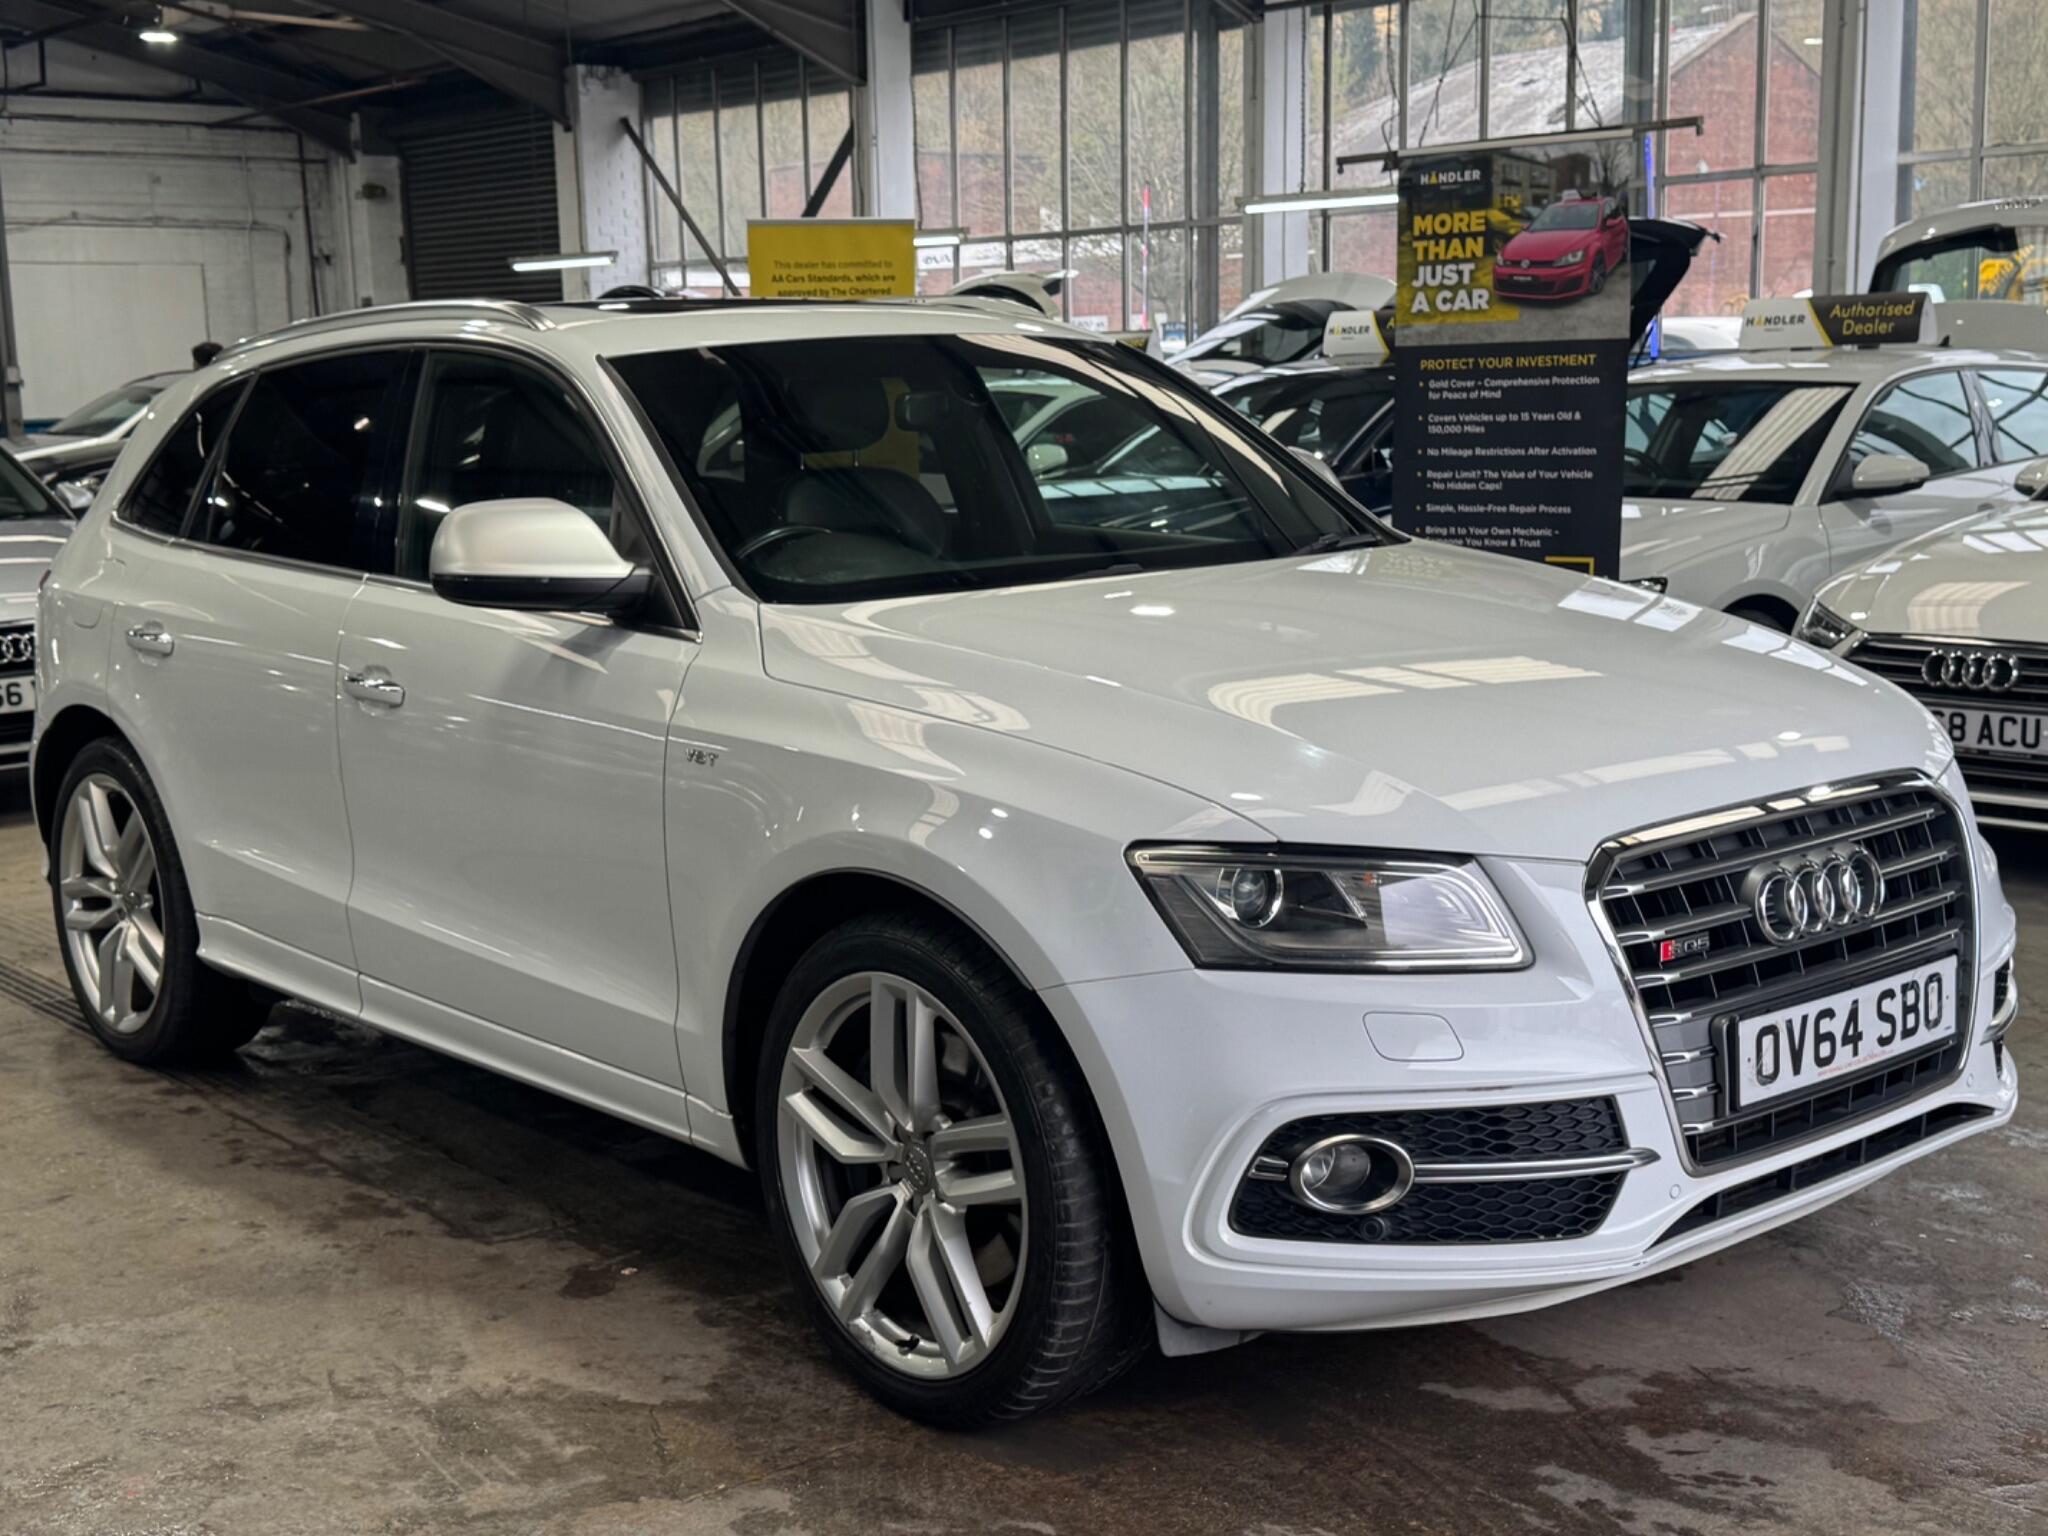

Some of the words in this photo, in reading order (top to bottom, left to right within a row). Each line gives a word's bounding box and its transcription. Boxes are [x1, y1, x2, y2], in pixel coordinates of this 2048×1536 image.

[1413, 210, 1486, 236] MORE
[1413, 237, 1483, 261] THAN
[774, 260, 792, 270] This
[793, 260, 819, 269] dealer
[821, 260, 836, 269] has
[838, 259, 882, 268] committed
[884, 259, 893, 268] to
[771, 274, 785, 283] AA
[786, 274, 805, 283] Cars
[856, 273, 880, 282] which
[883, 274, 896, 282] are
[1412, 262, 1475, 287] JUST
[820, 288, 830, 297] by
[831, 287, 846, 296] The
[848, 287, 892, 295] Chartered
[1410, 291, 1430, 313] A
[1435, 288, 1490, 311] CAR
[1829, 300, 1915, 319] Authorised
[1842, 318, 1894, 336] Dealer
[1420, 358, 1475, 371] PROTECT
[1478, 356, 1513, 369] YOUR
[1516, 354, 1597, 367] INVESTMENT
[1429, 378, 1449, 389] Gold
[1450, 378, 1475, 389] Cover
[1484, 375, 1550, 388] Comprehensive
[1552, 374, 1600, 385] Protection
[1428, 390, 1440, 400] for
[1442, 391, 1467, 399] Peace
[1470, 390, 1479, 399] of
[1480, 389, 1501, 399] Mind
[1428, 413, 1457, 423] Covers
[1458, 412, 1494, 423] Vehicles
[1496, 414, 1507, 424] up
[1509, 413, 1518, 422] to
[1521, 412, 1530, 421] 15
[1532, 412, 1554, 421] Years
[1557, 411, 1572, 420] Old
[1574, 411, 1582, 420] &
[1428, 424, 1462, 435] 150,000
[1464, 424, 1485, 434] Miles
[1426, 447, 1439, 457] No
[1441, 447, 1473, 458] Mileage
[1475, 447, 1525, 456] Restrictions
[1527, 446, 1549, 456] After
[1551, 446, 1597, 456] Activation
[1426, 470, 1453, 480] Repair
[1455, 469, 1481, 479] Limit?
[1483, 469, 1499, 479] The
[1501, 469, 1525, 479] Value
[1527, 469, 1536, 479] of
[1538, 470, 1558, 479] Your
[1560, 469, 1593, 479] Vehicle
[1433, 481, 1445, 490] No
[1447, 481, 1477, 490] Hidden
[1479, 481, 1502, 491] Caps!
[1426, 504, 1456, 514] Simple,
[1458, 504, 1507, 513] Hassle-Free
[1509, 504, 1537, 514] Repair
[1539, 504, 1571, 514] Process
[1425, 526, 1448, 536] Bring
[1457, 527, 1466, 535] to
[1468, 527, 1489, 535] Your
[1491, 527, 1510, 536] Own
[1513, 527, 1552, 536] Mechanic
[1426, 537, 1464, 546] eone
[1466, 538, 1482, 546] You
[1484, 538, 1508, 547] Know
[1510, 538, 1517, 547] &
[1519, 538, 1541, 547] Trust
[0, 682, 22, 708] 6
[1976, 714, 2041, 749] ACU
[1756, 998, 1864, 1086] OV64
[1876, 972, 1943, 1047] SBO
